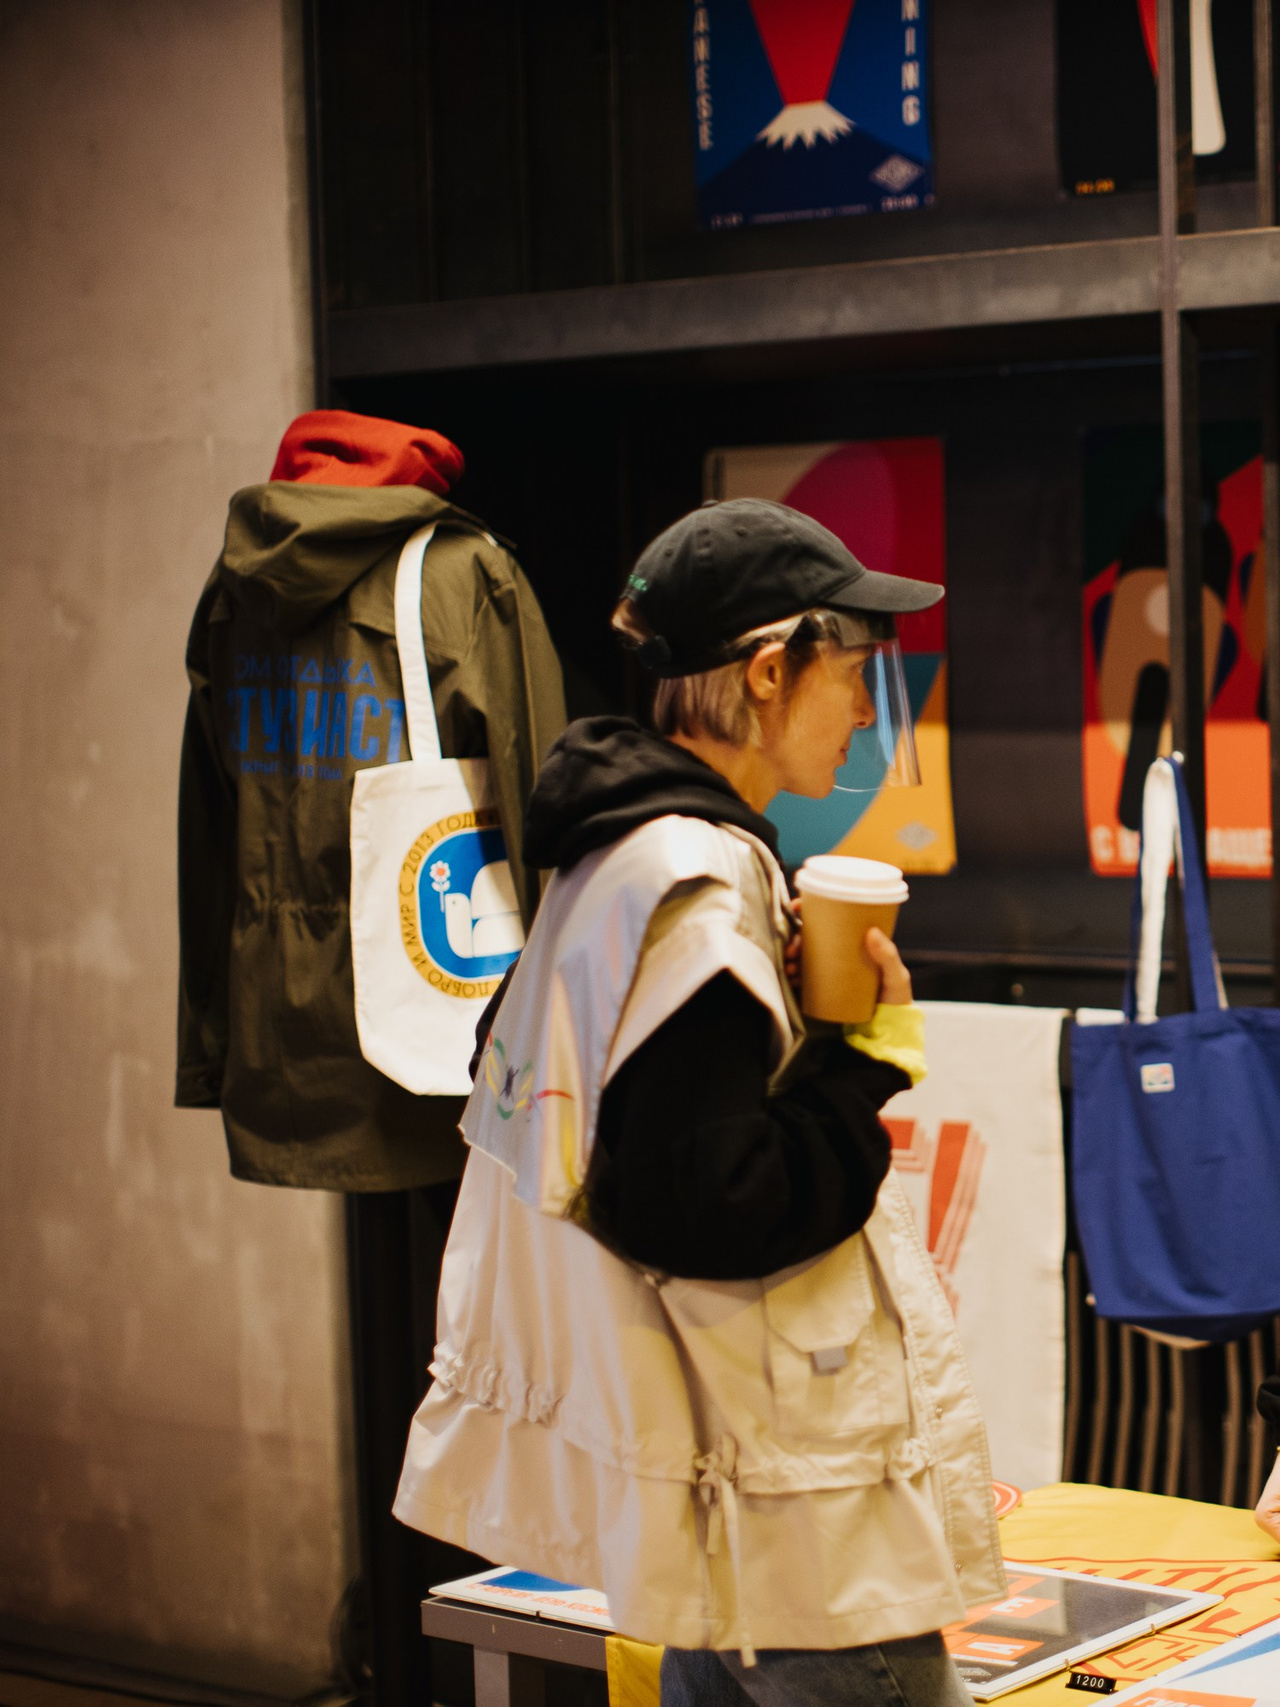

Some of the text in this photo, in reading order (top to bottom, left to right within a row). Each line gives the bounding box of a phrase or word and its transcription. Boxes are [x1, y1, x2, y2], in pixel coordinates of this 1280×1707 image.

[402, 832, 434, 875] 2013
[400, 883, 415, 897] С
[400, 904, 420, 947] МИР
[1076, 1674, 1105, 1690] 1200
